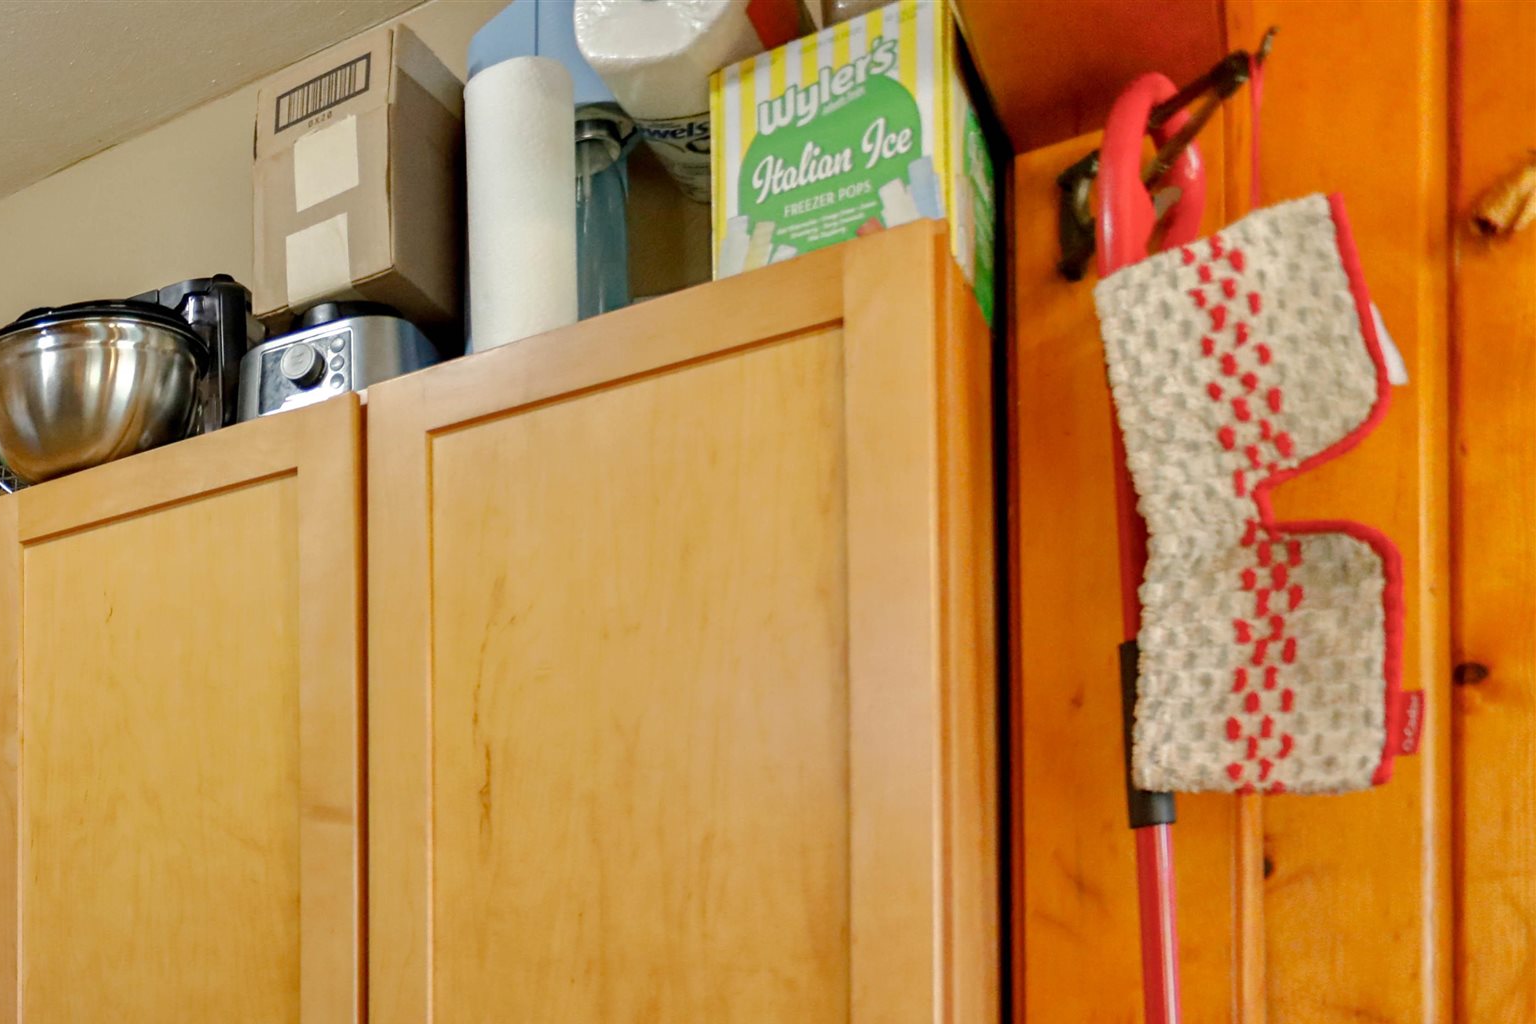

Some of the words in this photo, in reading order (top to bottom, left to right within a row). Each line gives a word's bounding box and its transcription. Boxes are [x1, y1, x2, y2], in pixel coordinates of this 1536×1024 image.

[758, 34, 898, 135] Wyler's
[752, 141, 853, 204] Italian
[861, 117, 912, 168] Ice
[783, 191, 835, 217] FREEZER
[837, 180, 873, 200] POPS
